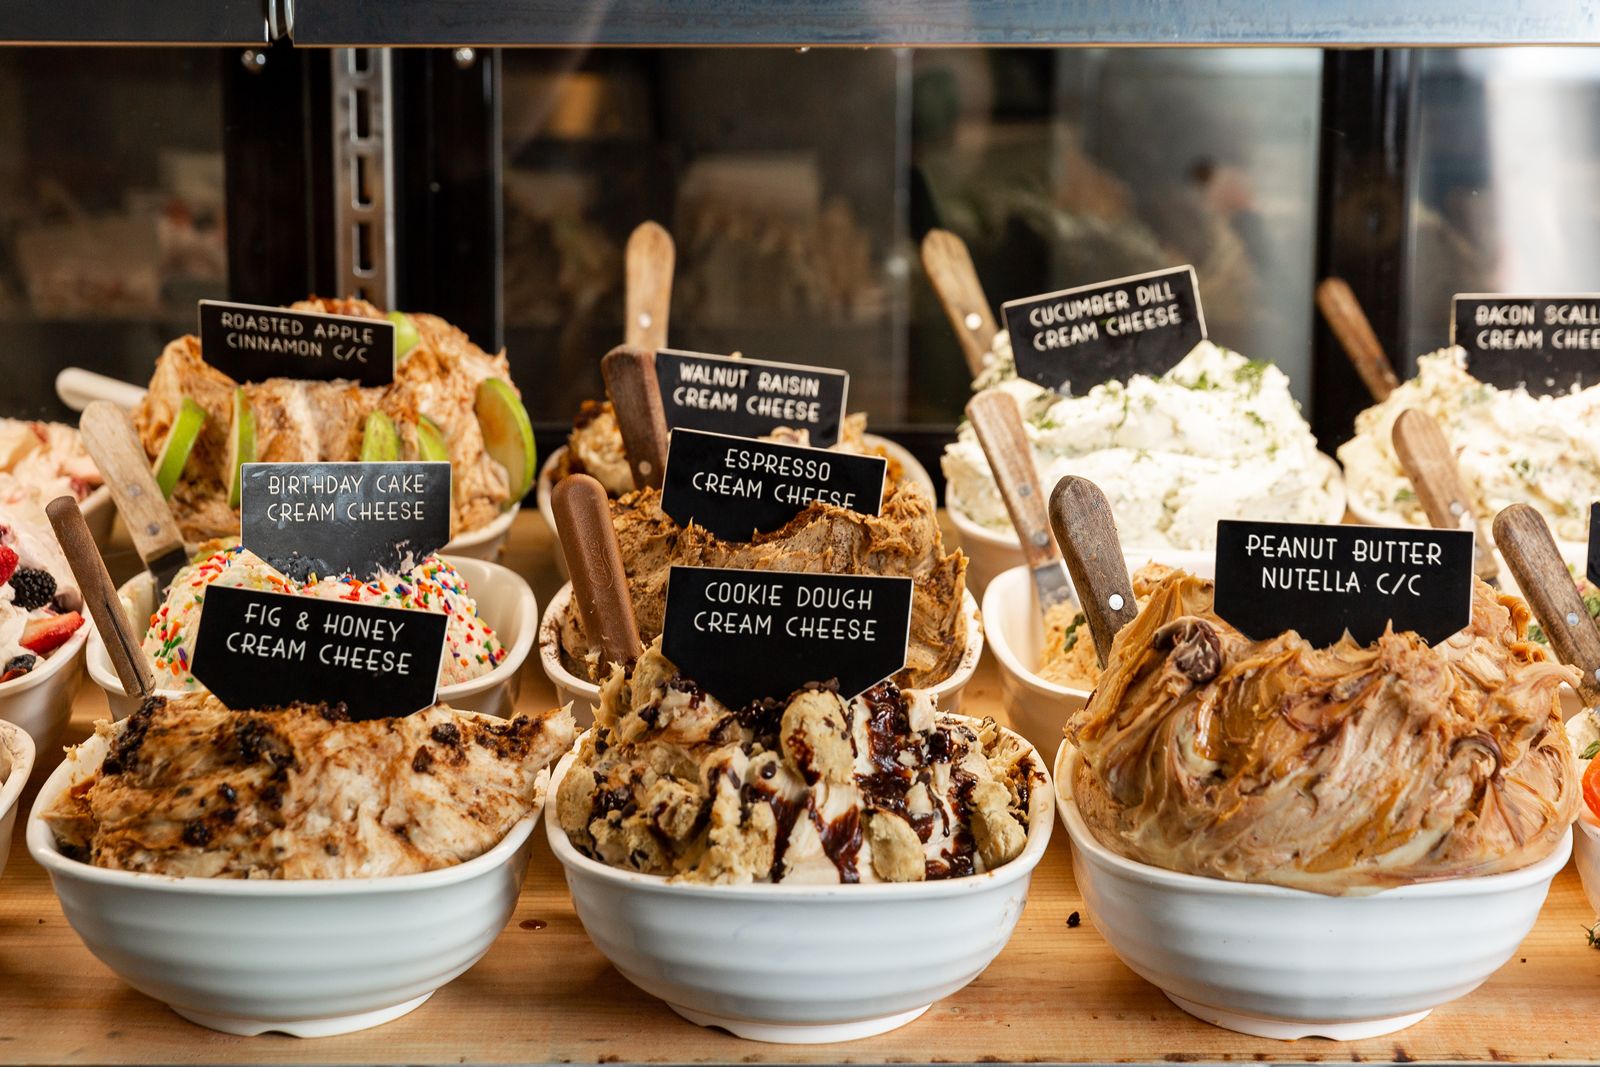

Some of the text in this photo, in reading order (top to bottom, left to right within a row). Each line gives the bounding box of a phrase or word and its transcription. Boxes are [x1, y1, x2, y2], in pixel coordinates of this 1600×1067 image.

[1029, 281, 1176, 328] CUCUMBER DILL
[1475, 304, 1535, 326] BACON
[221, 312, 374, 345] ROASTED APPLE
[1033, 303, 1182, 351] CREAM CHEESE
[1476, 328, 1543, 350] CREAM
[226, 332, 368, 363] CINNAMON C/C
[680, 362, 820, 398] WALNUT RAISIN
[673, 386, 821, 423] CREAM CHEESE
[724, 448, 831, 482] ESPRESSO
[267, 473, 425, 495] BIRTHDAY CAKE
[692, 472, 763, 499] CREAM
[267, 501, 425, 522] CREAM CHEESE
[1245, 534, 1442, 565] PEANUT BUTTER
[705, 581, 873, 611] COOKIE DOUGH
[1262, 566, 1421, 596] NUTELLA C/C
[244, 602, 405, 643] FIG & HONEY
[693, 611, 877, 642] CREAM CHEESE
[226, 631, 413, 675] CREAM CHEESE
